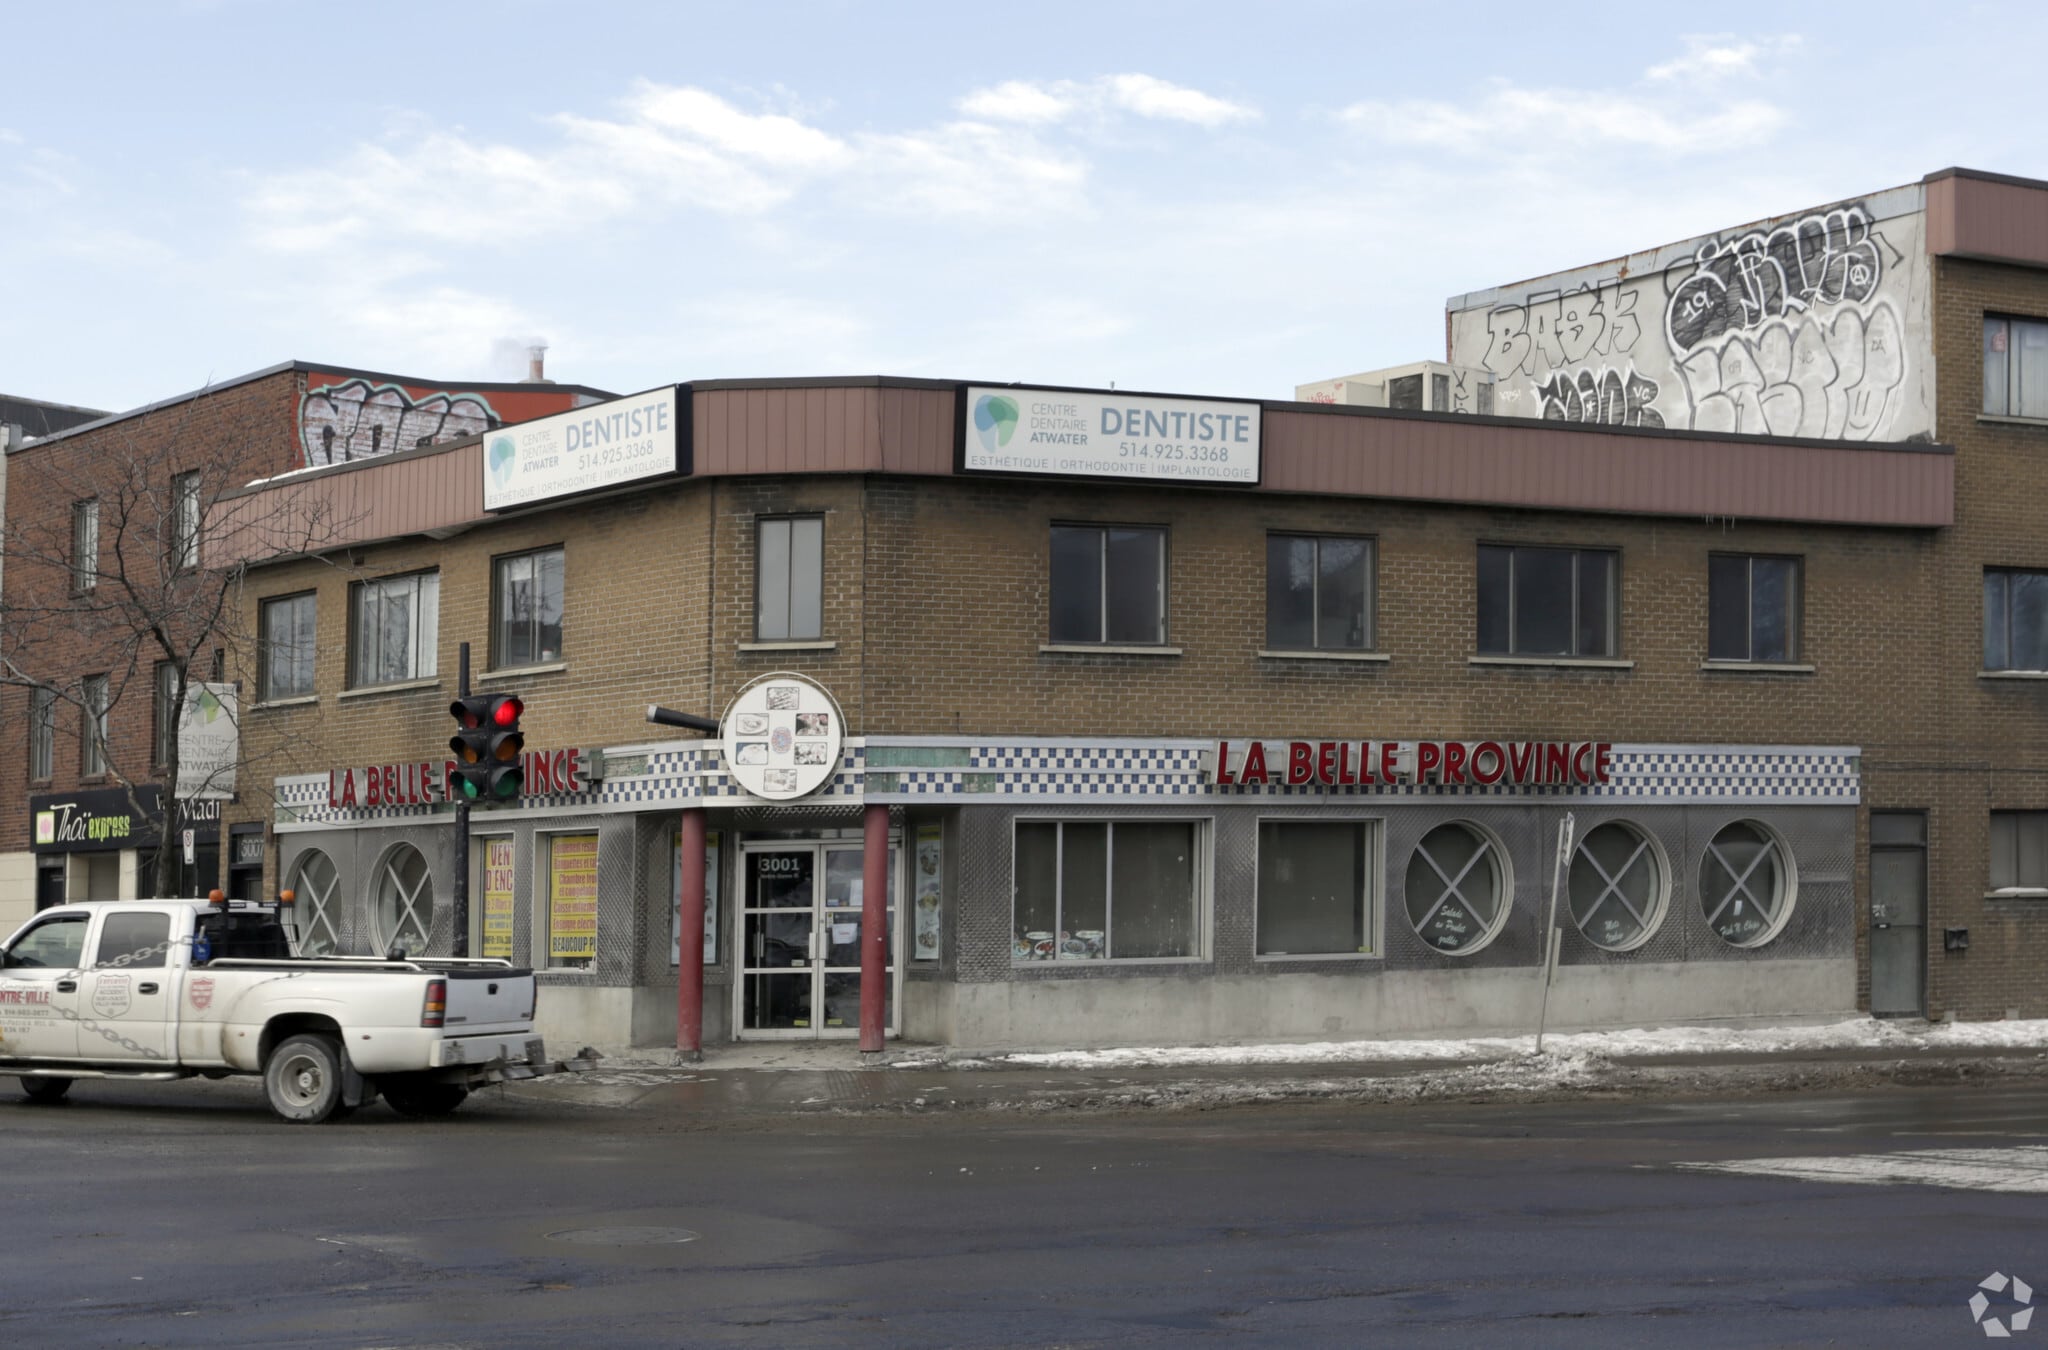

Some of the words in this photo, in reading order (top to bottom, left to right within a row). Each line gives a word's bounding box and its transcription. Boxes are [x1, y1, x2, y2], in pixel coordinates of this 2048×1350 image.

[1031, 402, 1078, 417] CENTRE
[566, 402, 668, 453] DENTISTE
[1030, 417, 1088, 432] DENTAIRE
[1100, 407, 1250, 443] DENTISTE
[522, 429, 551, 446] CENTRE
[1030, 433, 1088, 446] ATWATER
[522, 441, 559, 460] DENTAIRE
[578, 439, 654, 471] 514.925.3368
[1118, 442, 1229, 463] 514.925.3368
[522, 455, 559, 473] ATWATER
[541, 473, 597, 492] ORTHODONTIE
[604, 456, 671, 481] IMPLANTOLOGIE
[1060, 459, 1147, 474] ORTHODONTIE
[1157, 464, 1251, 479] IMPLANTOLOGIE
[1216, 741, 1270, 786] LA
[1288, 741, 1400, 786] BELLE
[1416, 741, 1613, 786] PROVINCE
[329, 768, 358, 808] LA
[367, 762, 433, 807] BELLE
[445, 748, 580, 803] PINCE
[88, 815, 130, 843] express
[761, 858, 800, 871] 3001
[553, 936, 587, 952] BEAUCOUP
